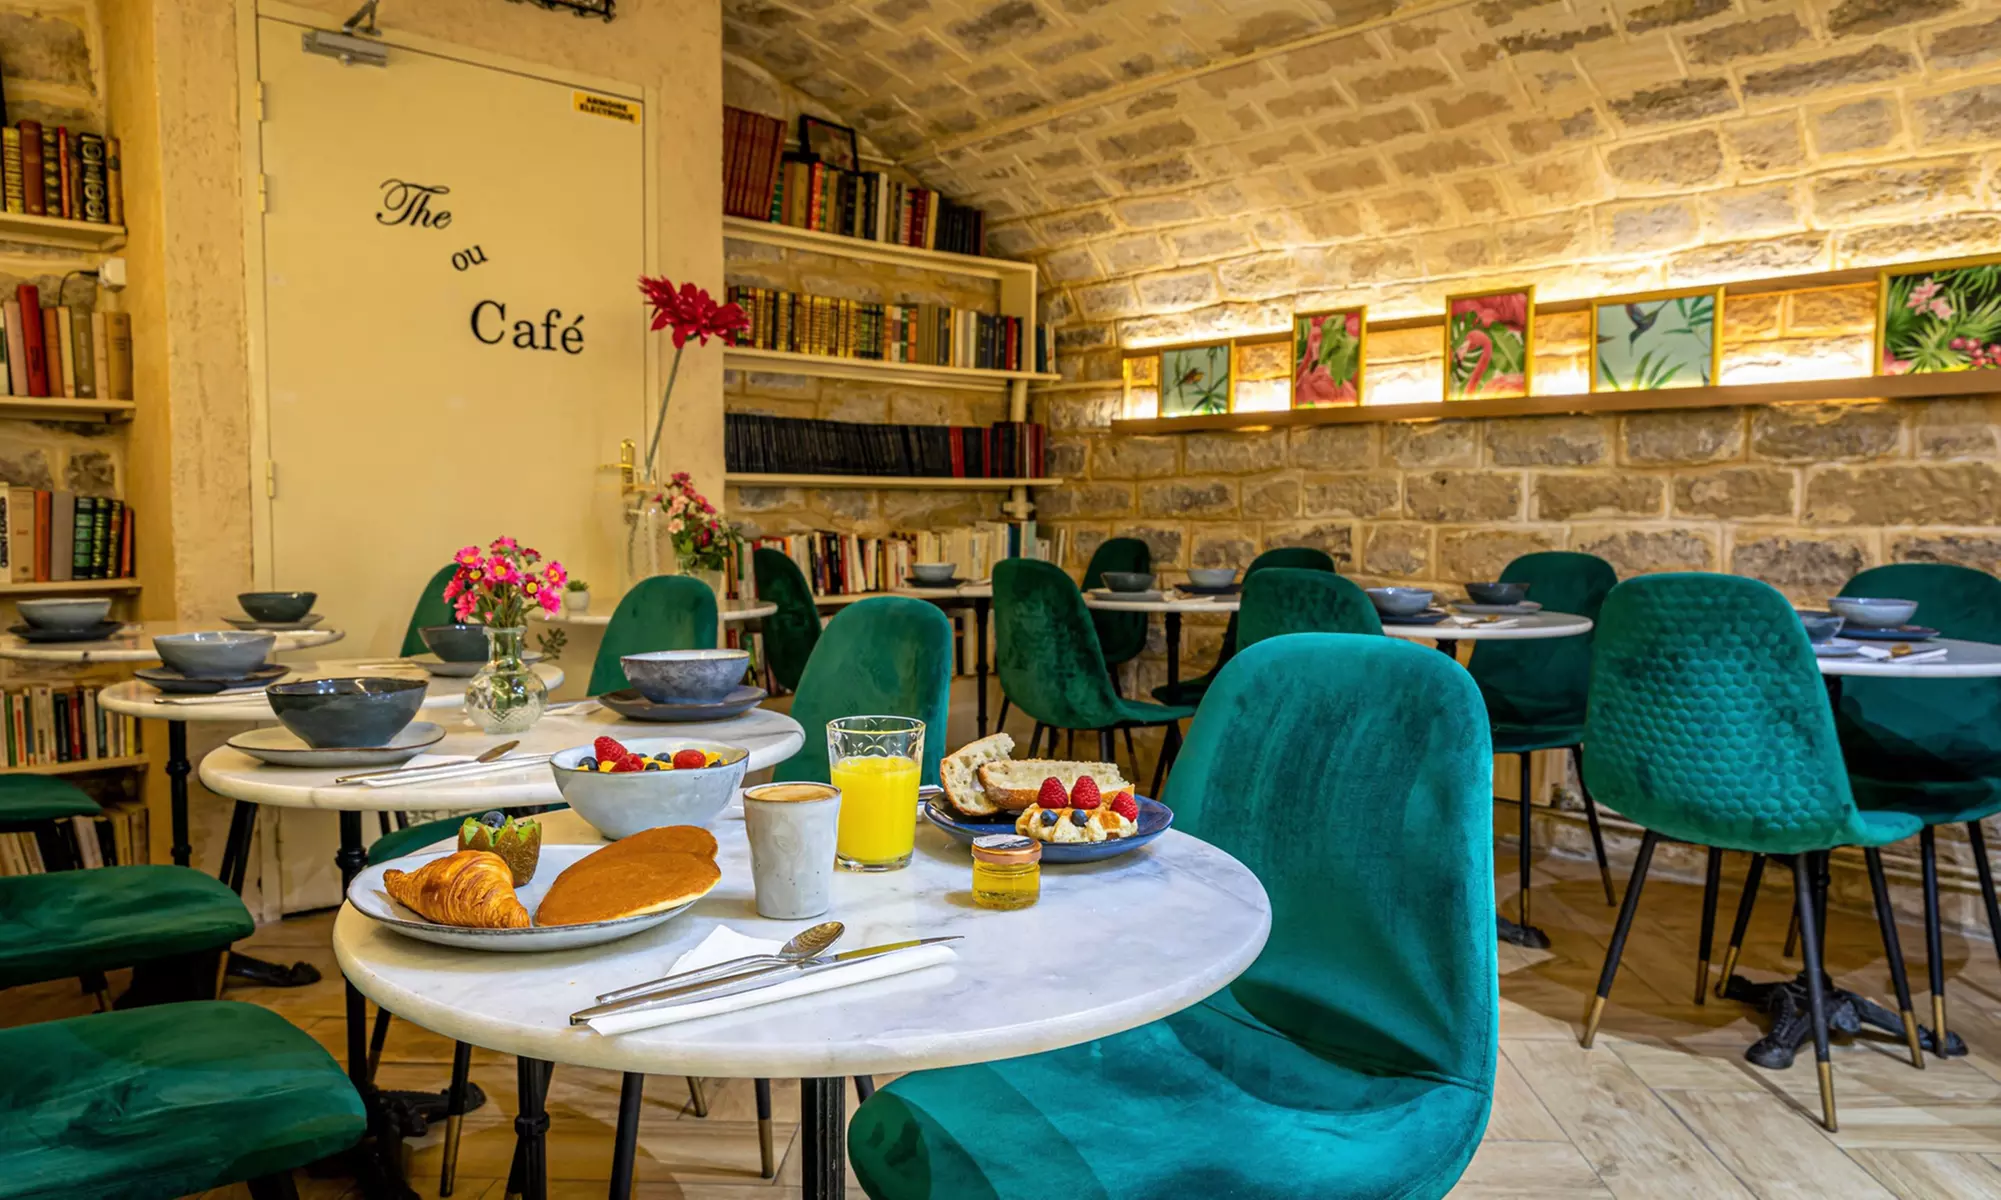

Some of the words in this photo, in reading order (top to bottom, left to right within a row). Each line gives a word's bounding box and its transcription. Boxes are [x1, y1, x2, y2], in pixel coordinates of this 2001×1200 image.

[579, 103, 635, 121] ELECTRIQUE
[586, 96, 628, 111] ARMOIRE
[376, 178, 452, 230] The
[451, 244, 488, 272] ou
[469, 299, 585, 355] Café
